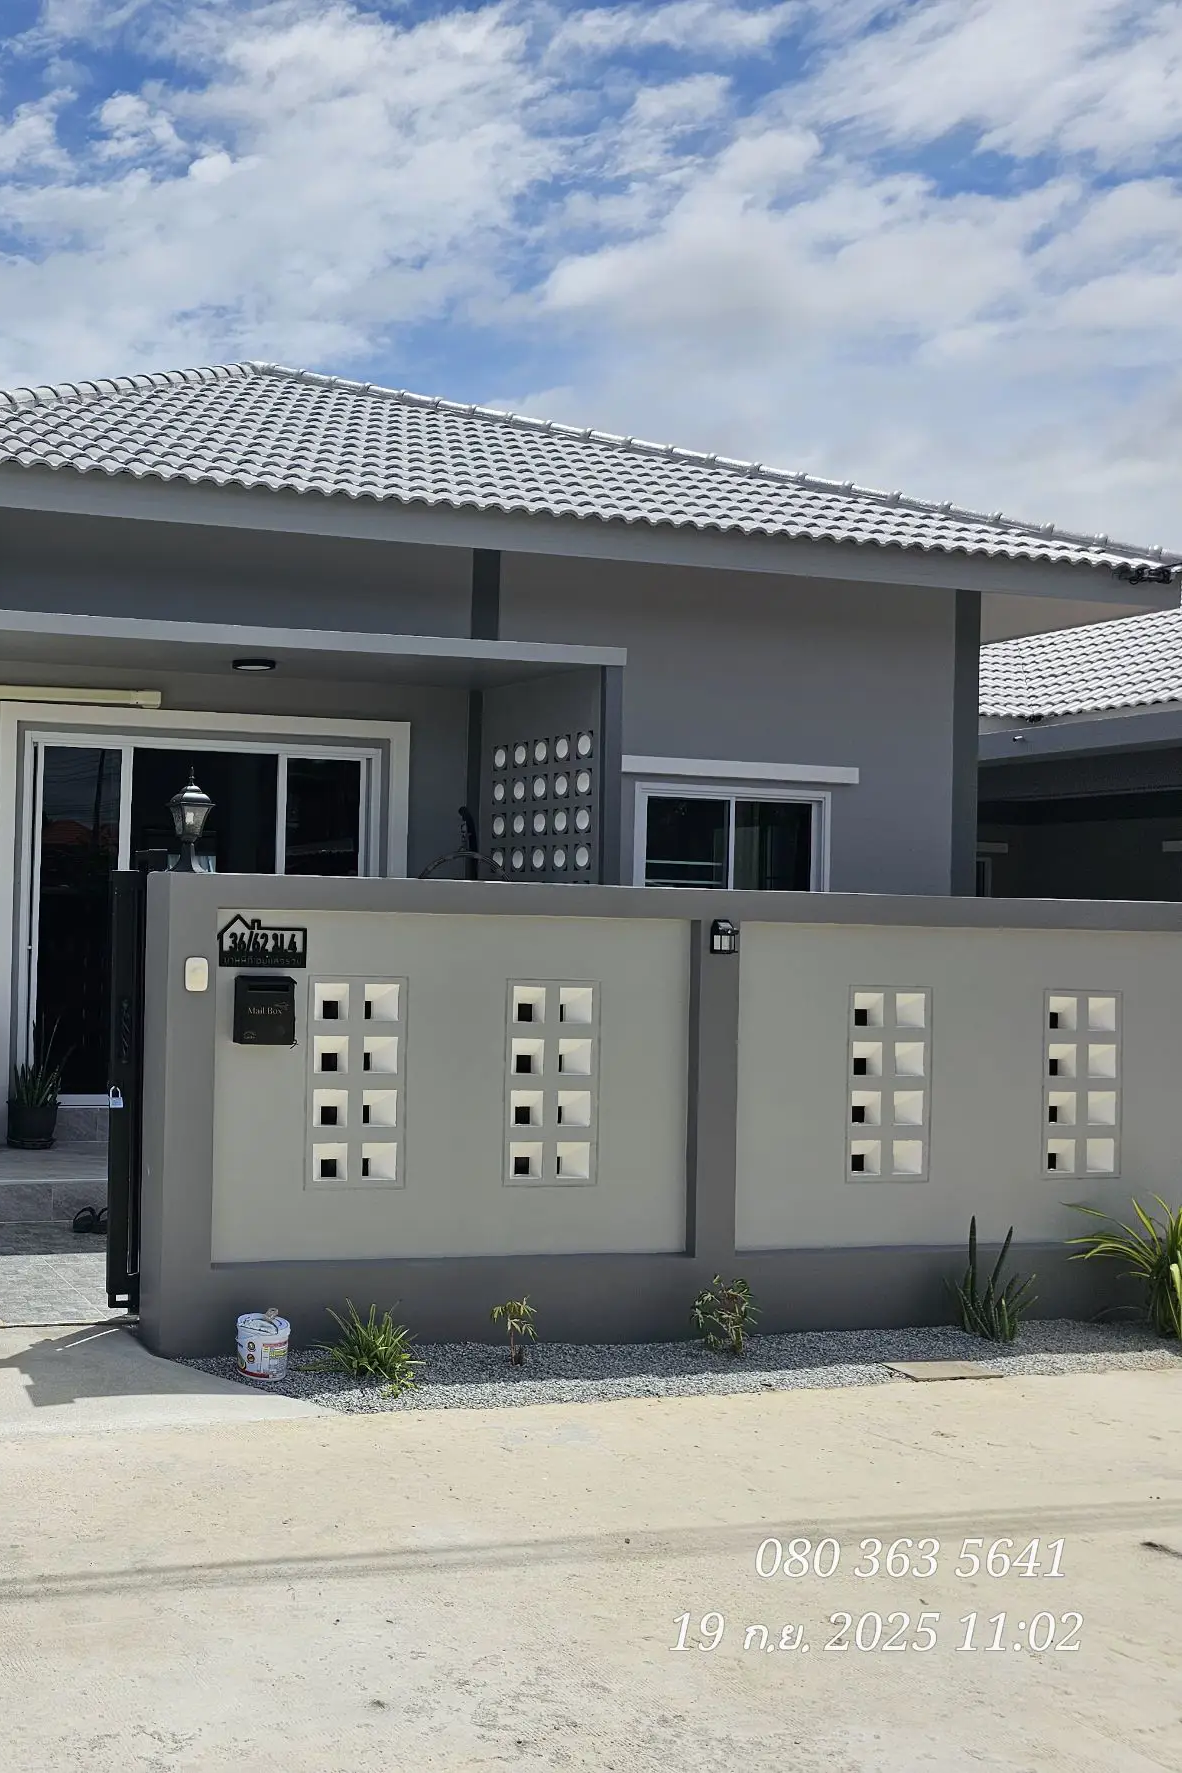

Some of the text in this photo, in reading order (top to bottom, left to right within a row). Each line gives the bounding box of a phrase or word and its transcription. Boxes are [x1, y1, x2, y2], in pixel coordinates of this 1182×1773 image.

[228, 930, 268, 951] 36/62
[248, 1006, 283, 1015] Mail Box
